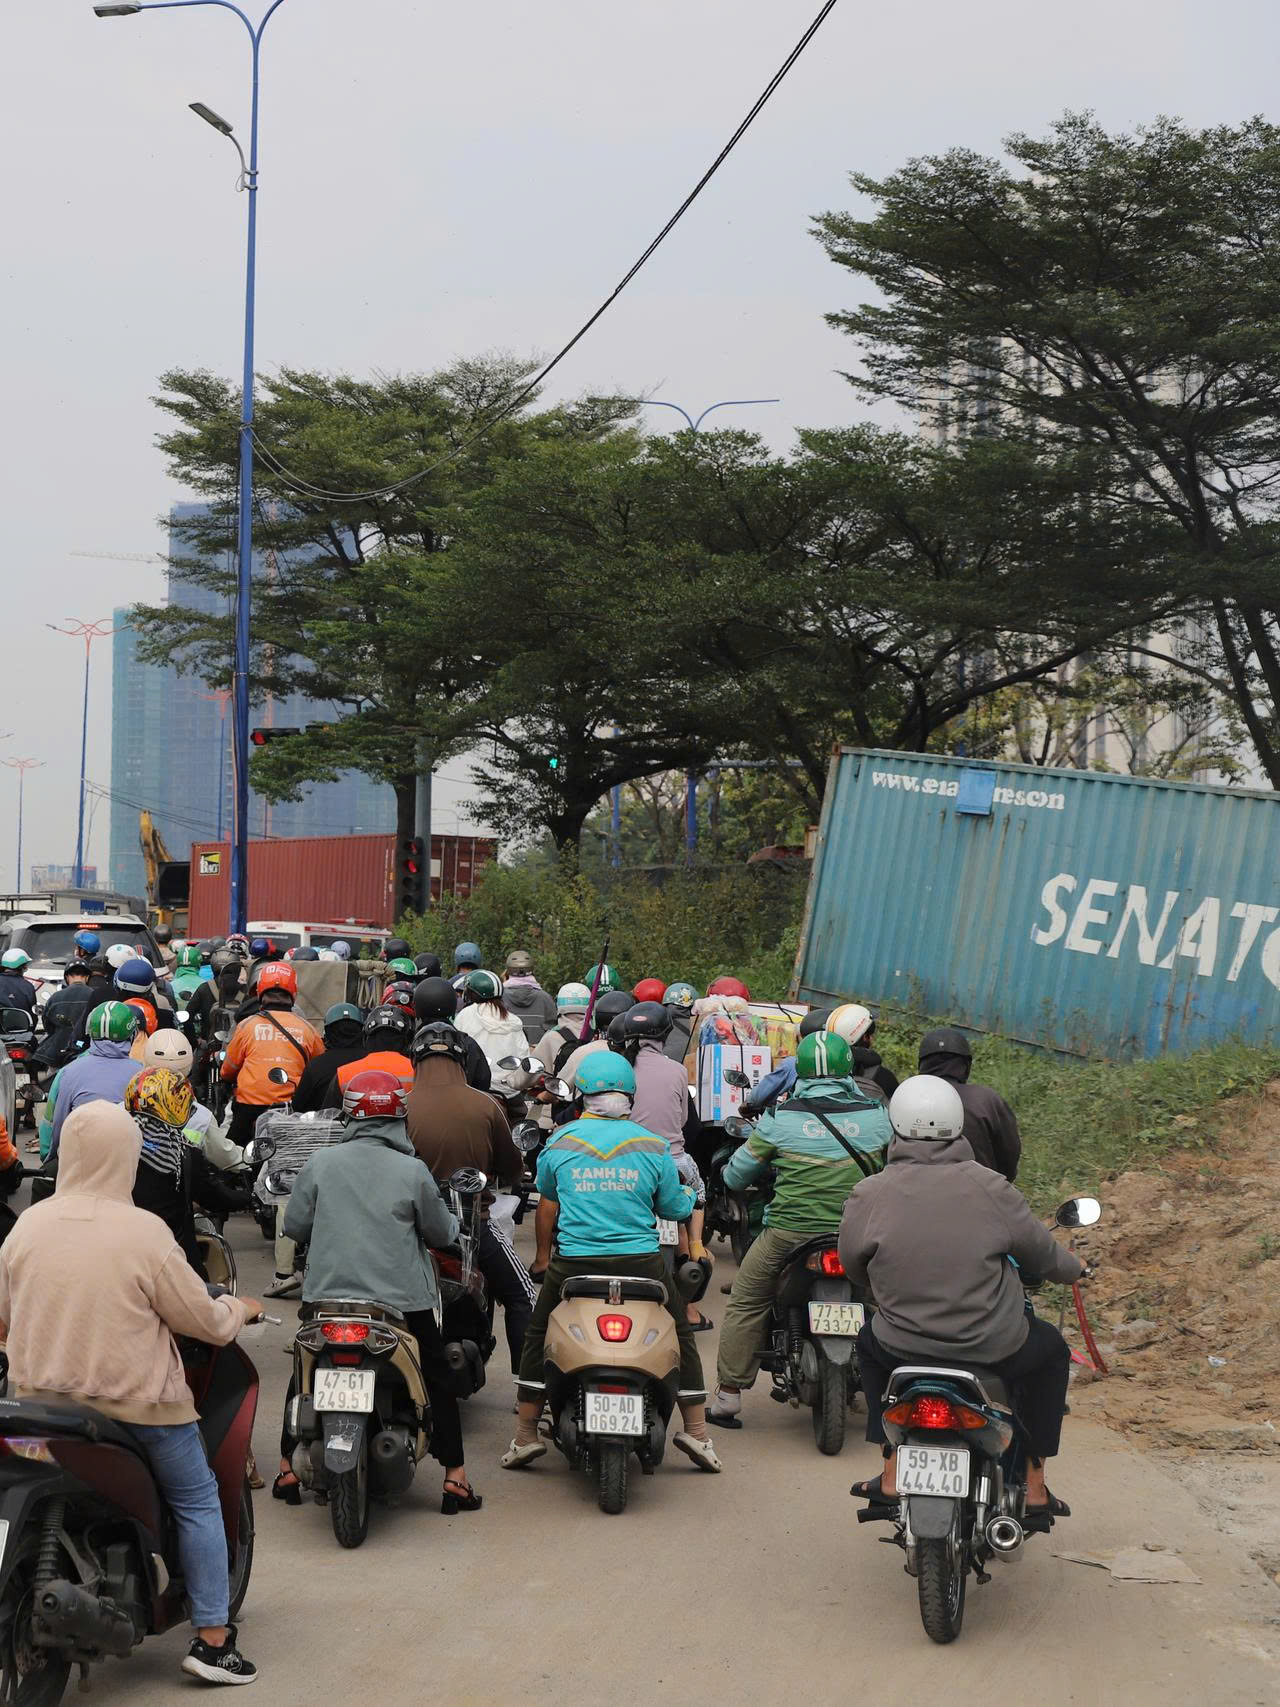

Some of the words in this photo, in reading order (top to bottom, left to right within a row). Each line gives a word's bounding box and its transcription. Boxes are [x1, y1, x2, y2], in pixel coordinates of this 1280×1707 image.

[275, 1031, 304, 1045] Fod
[571, 1167, 616, 1179] XANH
[619, 1167, 640, 1181] SM
[575, 1180, 596, 1192] xin
[817, 1304, 854, 1318] 77-F1
[813, 1319, 861, 1333] 733.70
[324, 1372, 365, 1390] 47-G1
[317, 1390, 369, 1409] 249.51
[594, 1396, 635, 1413] 50-AD
[590, 1413, 639, 1432] 069.24
[909, 1450, 959, 1472] 59-XB
[902, 1470, 963, 1494] 444.40
